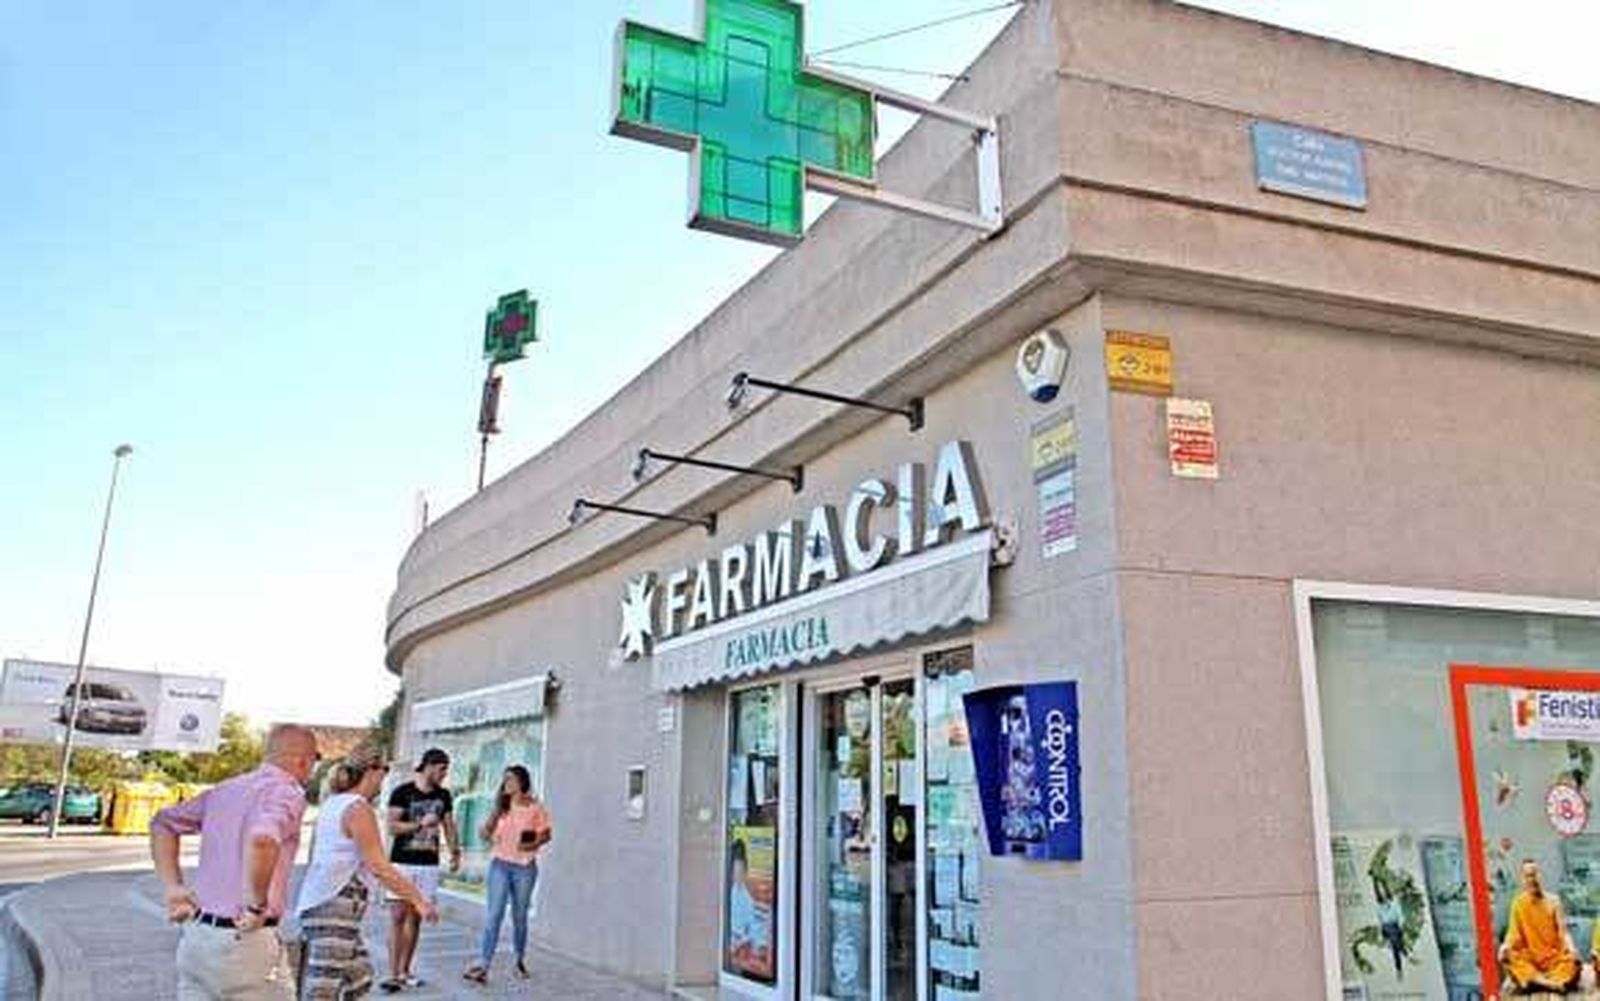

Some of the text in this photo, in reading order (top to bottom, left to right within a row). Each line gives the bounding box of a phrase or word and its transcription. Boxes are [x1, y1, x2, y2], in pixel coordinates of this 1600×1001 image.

[664, 440, 986, 635] FARMACIA
[724, 616, 830, 668] FARMACIA
[1044, 709, 1071, 832] CONTROL
